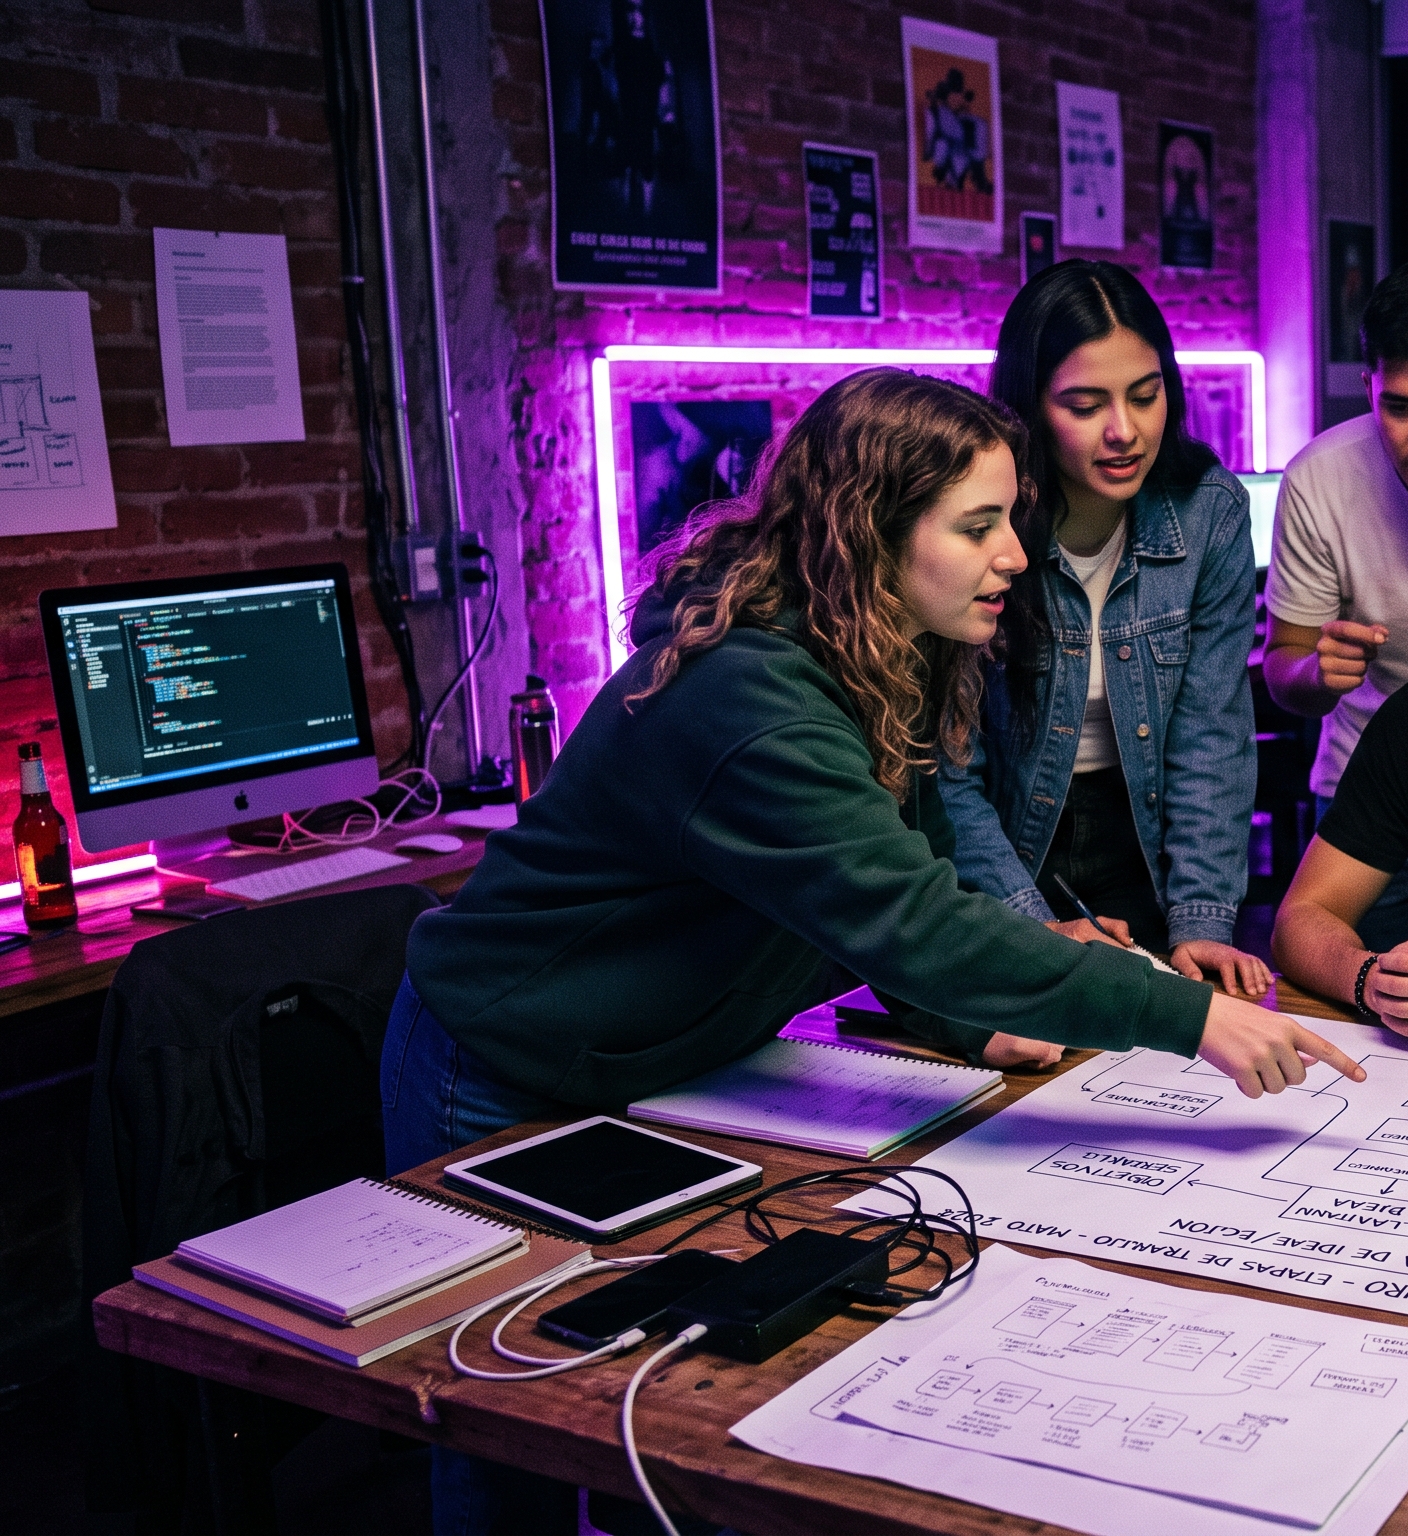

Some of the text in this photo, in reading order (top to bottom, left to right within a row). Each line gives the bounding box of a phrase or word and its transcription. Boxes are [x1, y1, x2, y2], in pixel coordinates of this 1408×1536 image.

[1006, 1219, 1072, 1239] MATO
[1197, 1253, 1234, 1268] DE
[1350, 1247, 1391, 1263] DE
[1238, 1260, 1334, 1286] ETAPAS
